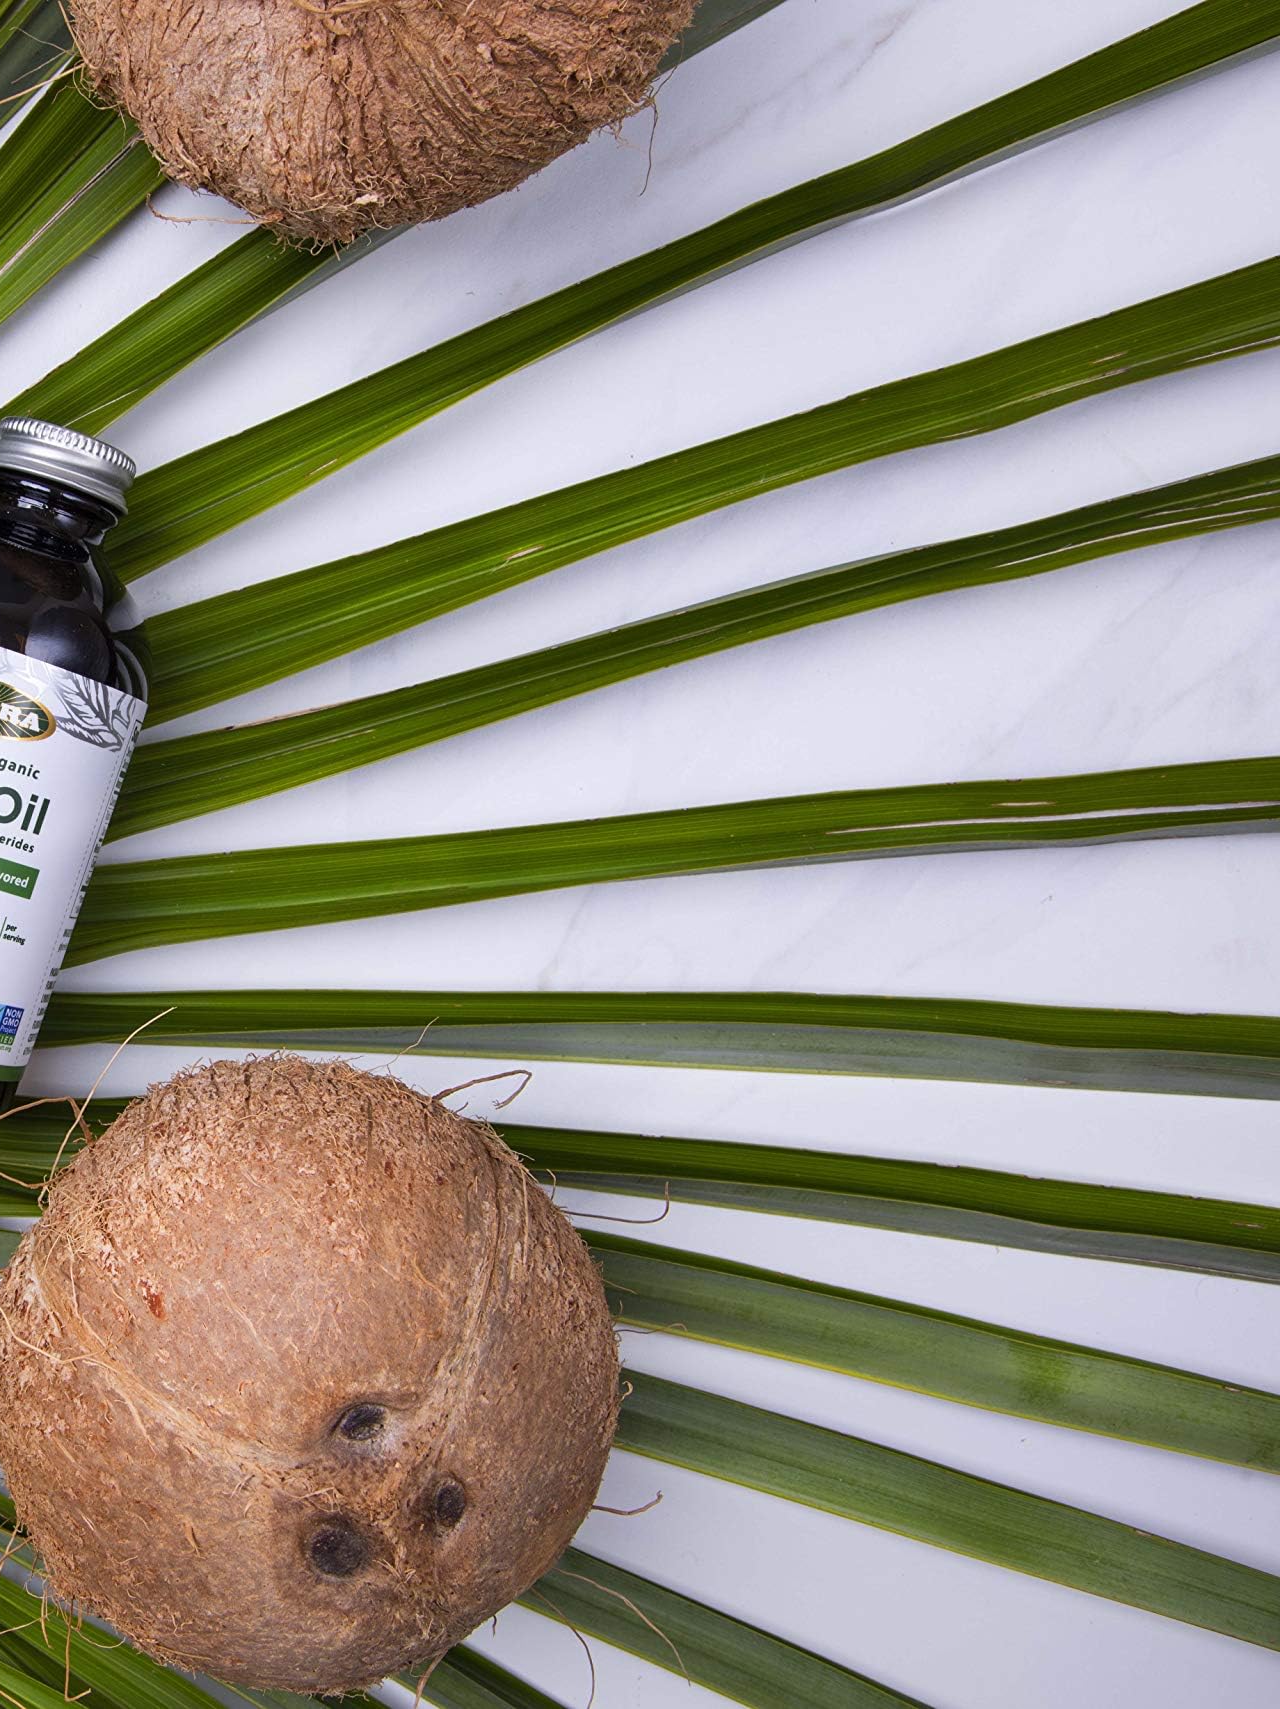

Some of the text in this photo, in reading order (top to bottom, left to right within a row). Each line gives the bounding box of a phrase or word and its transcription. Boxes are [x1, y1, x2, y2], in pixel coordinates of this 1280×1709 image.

[5, 922, 18, 933] per
[3, 931, 25, 946] serving
[5, 1008, 22, 1018] NON
[2, 1017, 19, 1027] GMO
